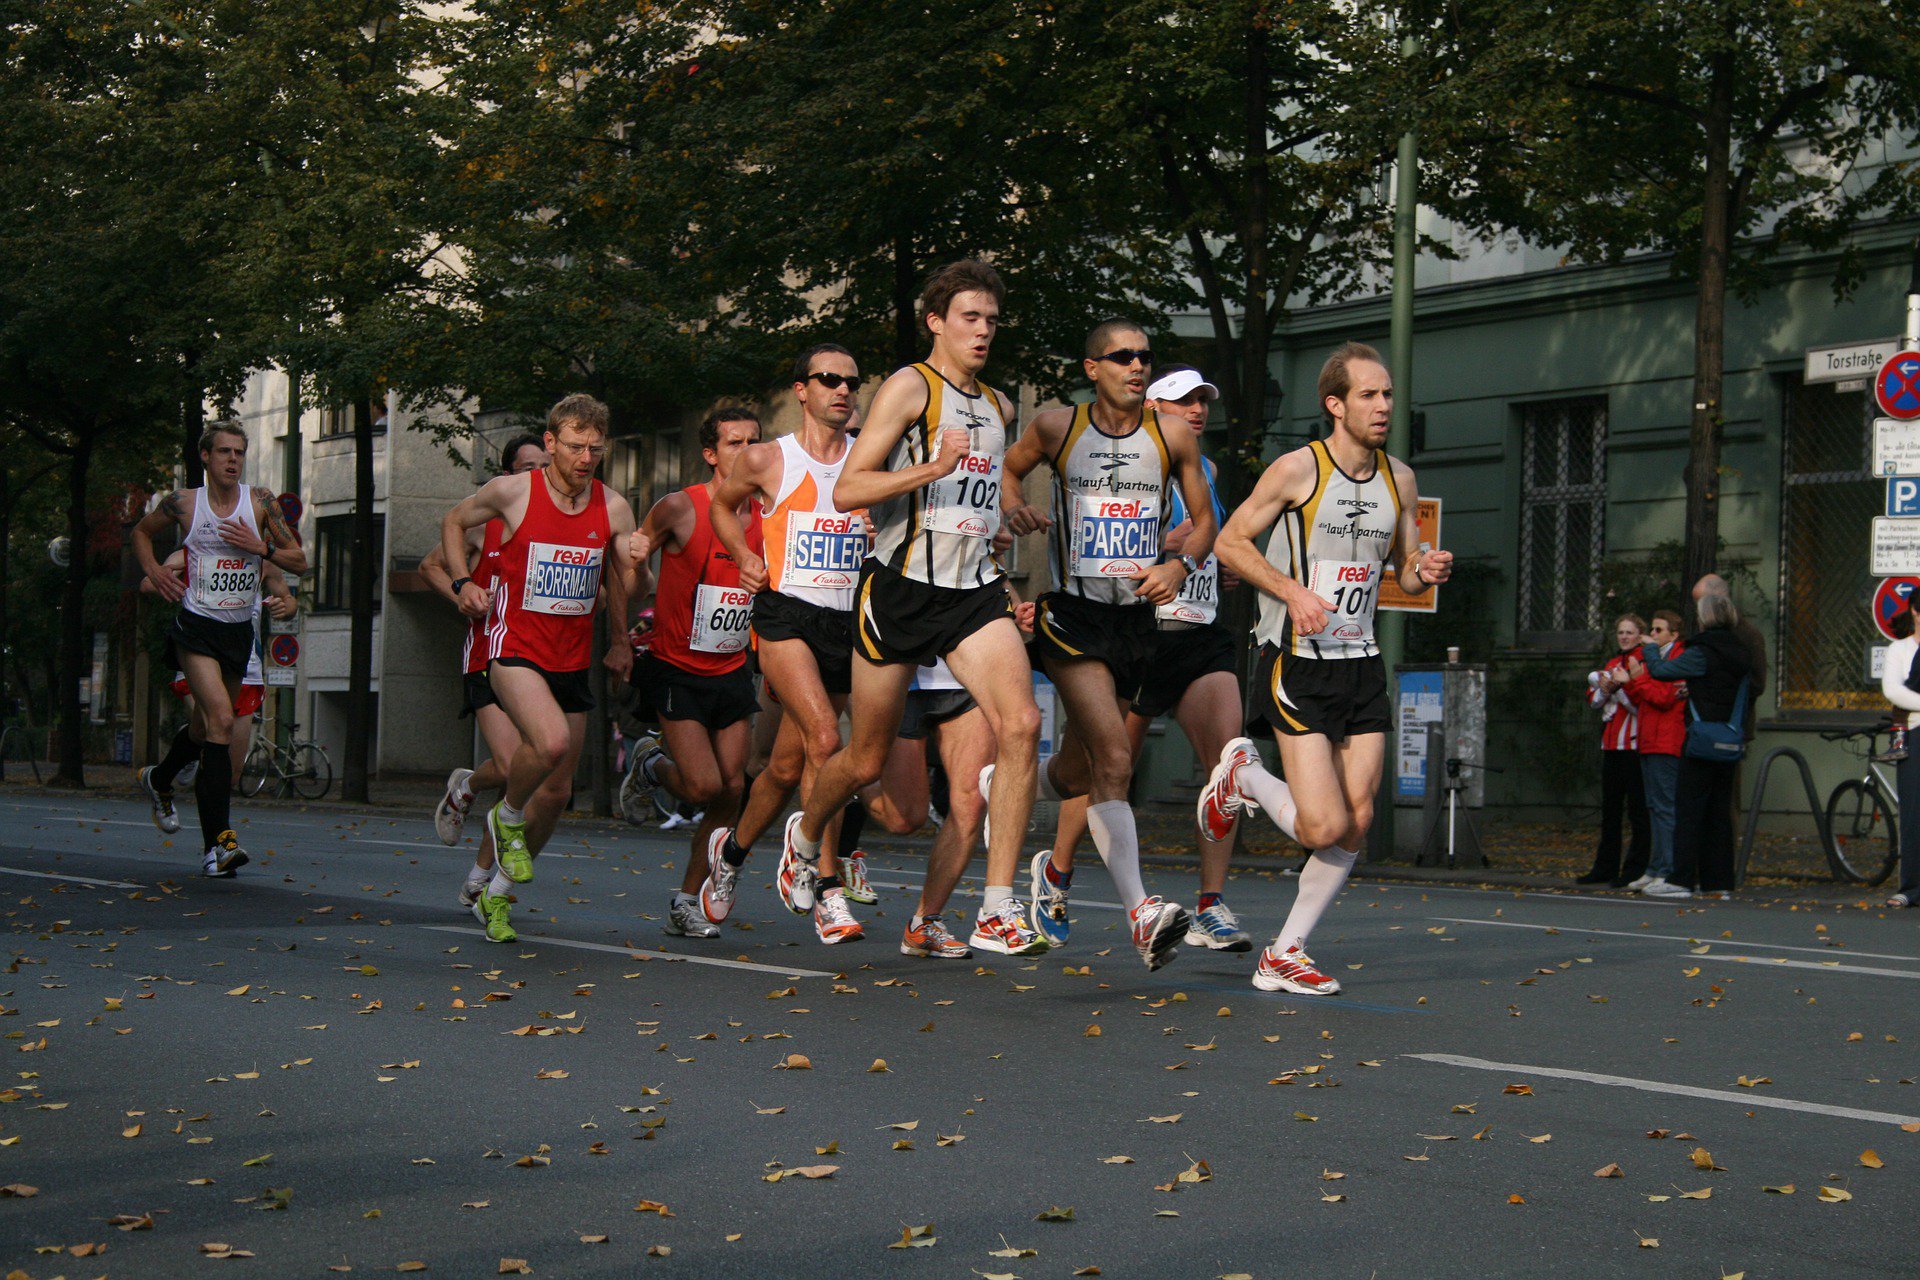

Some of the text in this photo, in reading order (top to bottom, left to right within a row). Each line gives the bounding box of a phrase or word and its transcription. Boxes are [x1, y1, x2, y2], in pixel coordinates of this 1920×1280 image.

[1827, 349, 1882, 369] Torstraße
[956, 408, 991, 423] BROOKS
[1089, 452, 1139, 460] BROOKS
[1078, 477, 1104, 490] lauf
[1115, 480, 1160, 493] partner
[957, 476, 997, 511] 102
[1895, 481, 1917, 512] P
[1337, 499, 1379, 509] BROOKS
[964, 522, 986, 534] Takeda
[1326, 522, 1348, 538] lauf
[1356, 528, 1392, 540] partner
[1081, 520, 1156, 557] PARCHI
[796, 533, 865, 570] SEILER
[1108, 565, 1136, 573] Takeda
[210, 572, 255, 592] 33882
[820, 576, 847, 585] Takeda
[557, 604, 582, 612] Takeda
[1333, 586, 1373, 615] 101
[1339, 629, 1361, 637] Takeda
